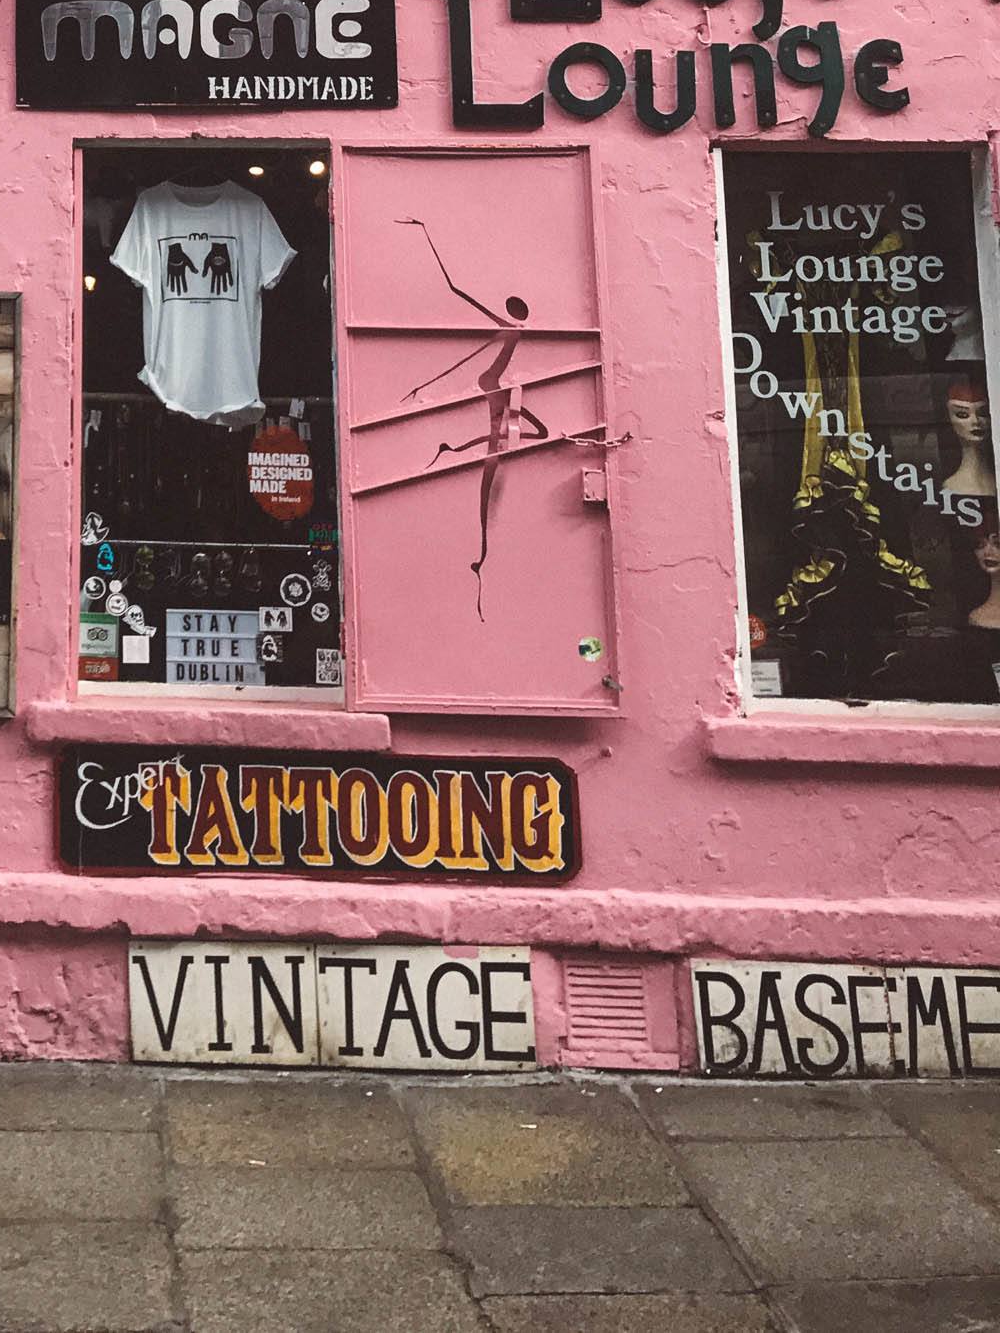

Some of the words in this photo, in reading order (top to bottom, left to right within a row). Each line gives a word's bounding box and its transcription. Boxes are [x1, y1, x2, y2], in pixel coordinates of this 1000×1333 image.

[208, 75, 374, 101] HANDMADE
[767, 190, 927, 239] Lucy's
[754, 241, 945, 292] Lounge
[750, 292, 948, 343] Vintage
[732, 332, 984, 527] Downstairs
[248, 452, 309, 466] IMAGINED
[251, 467, 312, 480] DESIGNED
[249, 480, 287, 493] MADE
[183, 614, 238, 632] STAY
[181, 639, 240, 657] TRUE
[75, 754, 185, 830] Expert
[140, 761, 566, 873] TATTOOING
[132, 955, 537, 1062] VINTAGE
[695, 971, 1000, 1077] BASEME
